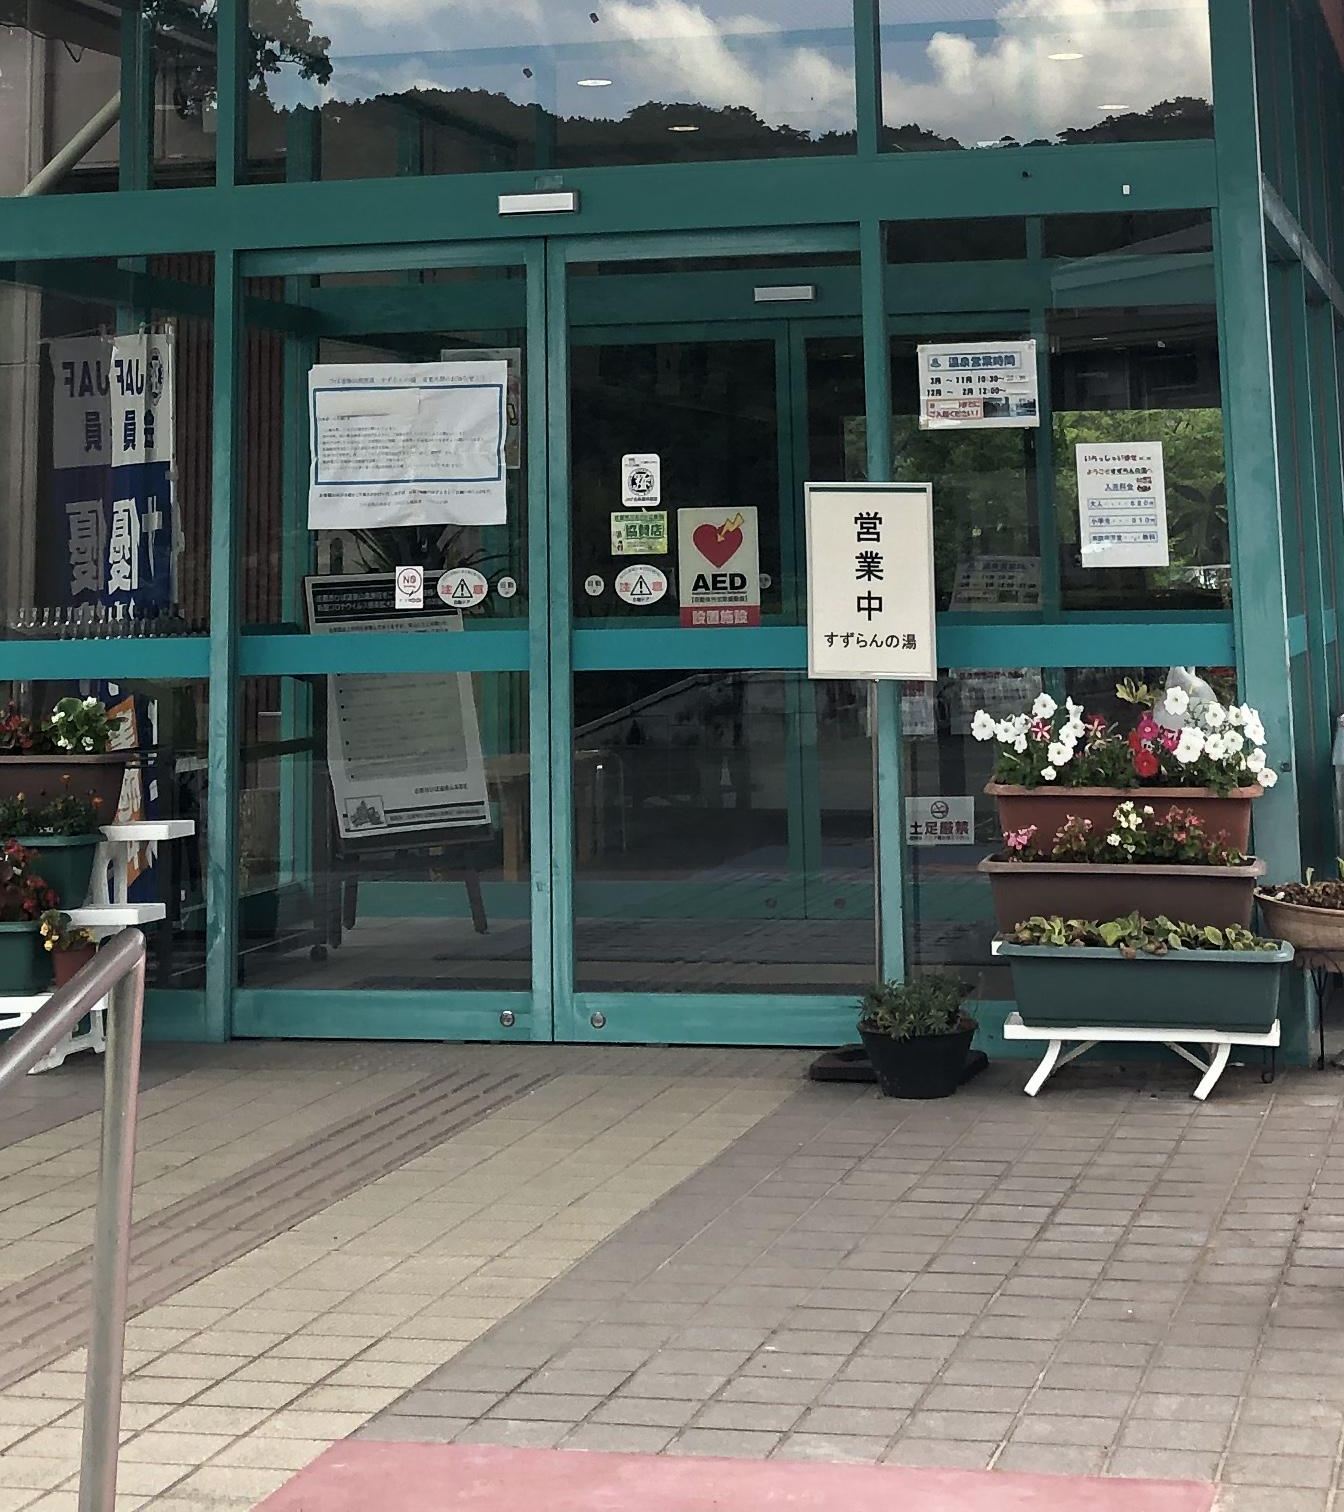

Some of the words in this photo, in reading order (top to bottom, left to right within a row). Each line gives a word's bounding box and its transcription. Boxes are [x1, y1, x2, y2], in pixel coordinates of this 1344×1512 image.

[948, 354, 1016, 368] 温泉営業時間
[853, 511, 884, 622] 営業中
[691, 572, 748, 591] AED
[692, 610, 749, 625] 設置施設
[824, 631, 918, 650] すずらんの湯
[909, 820, 969, 835] 土足厳禁
